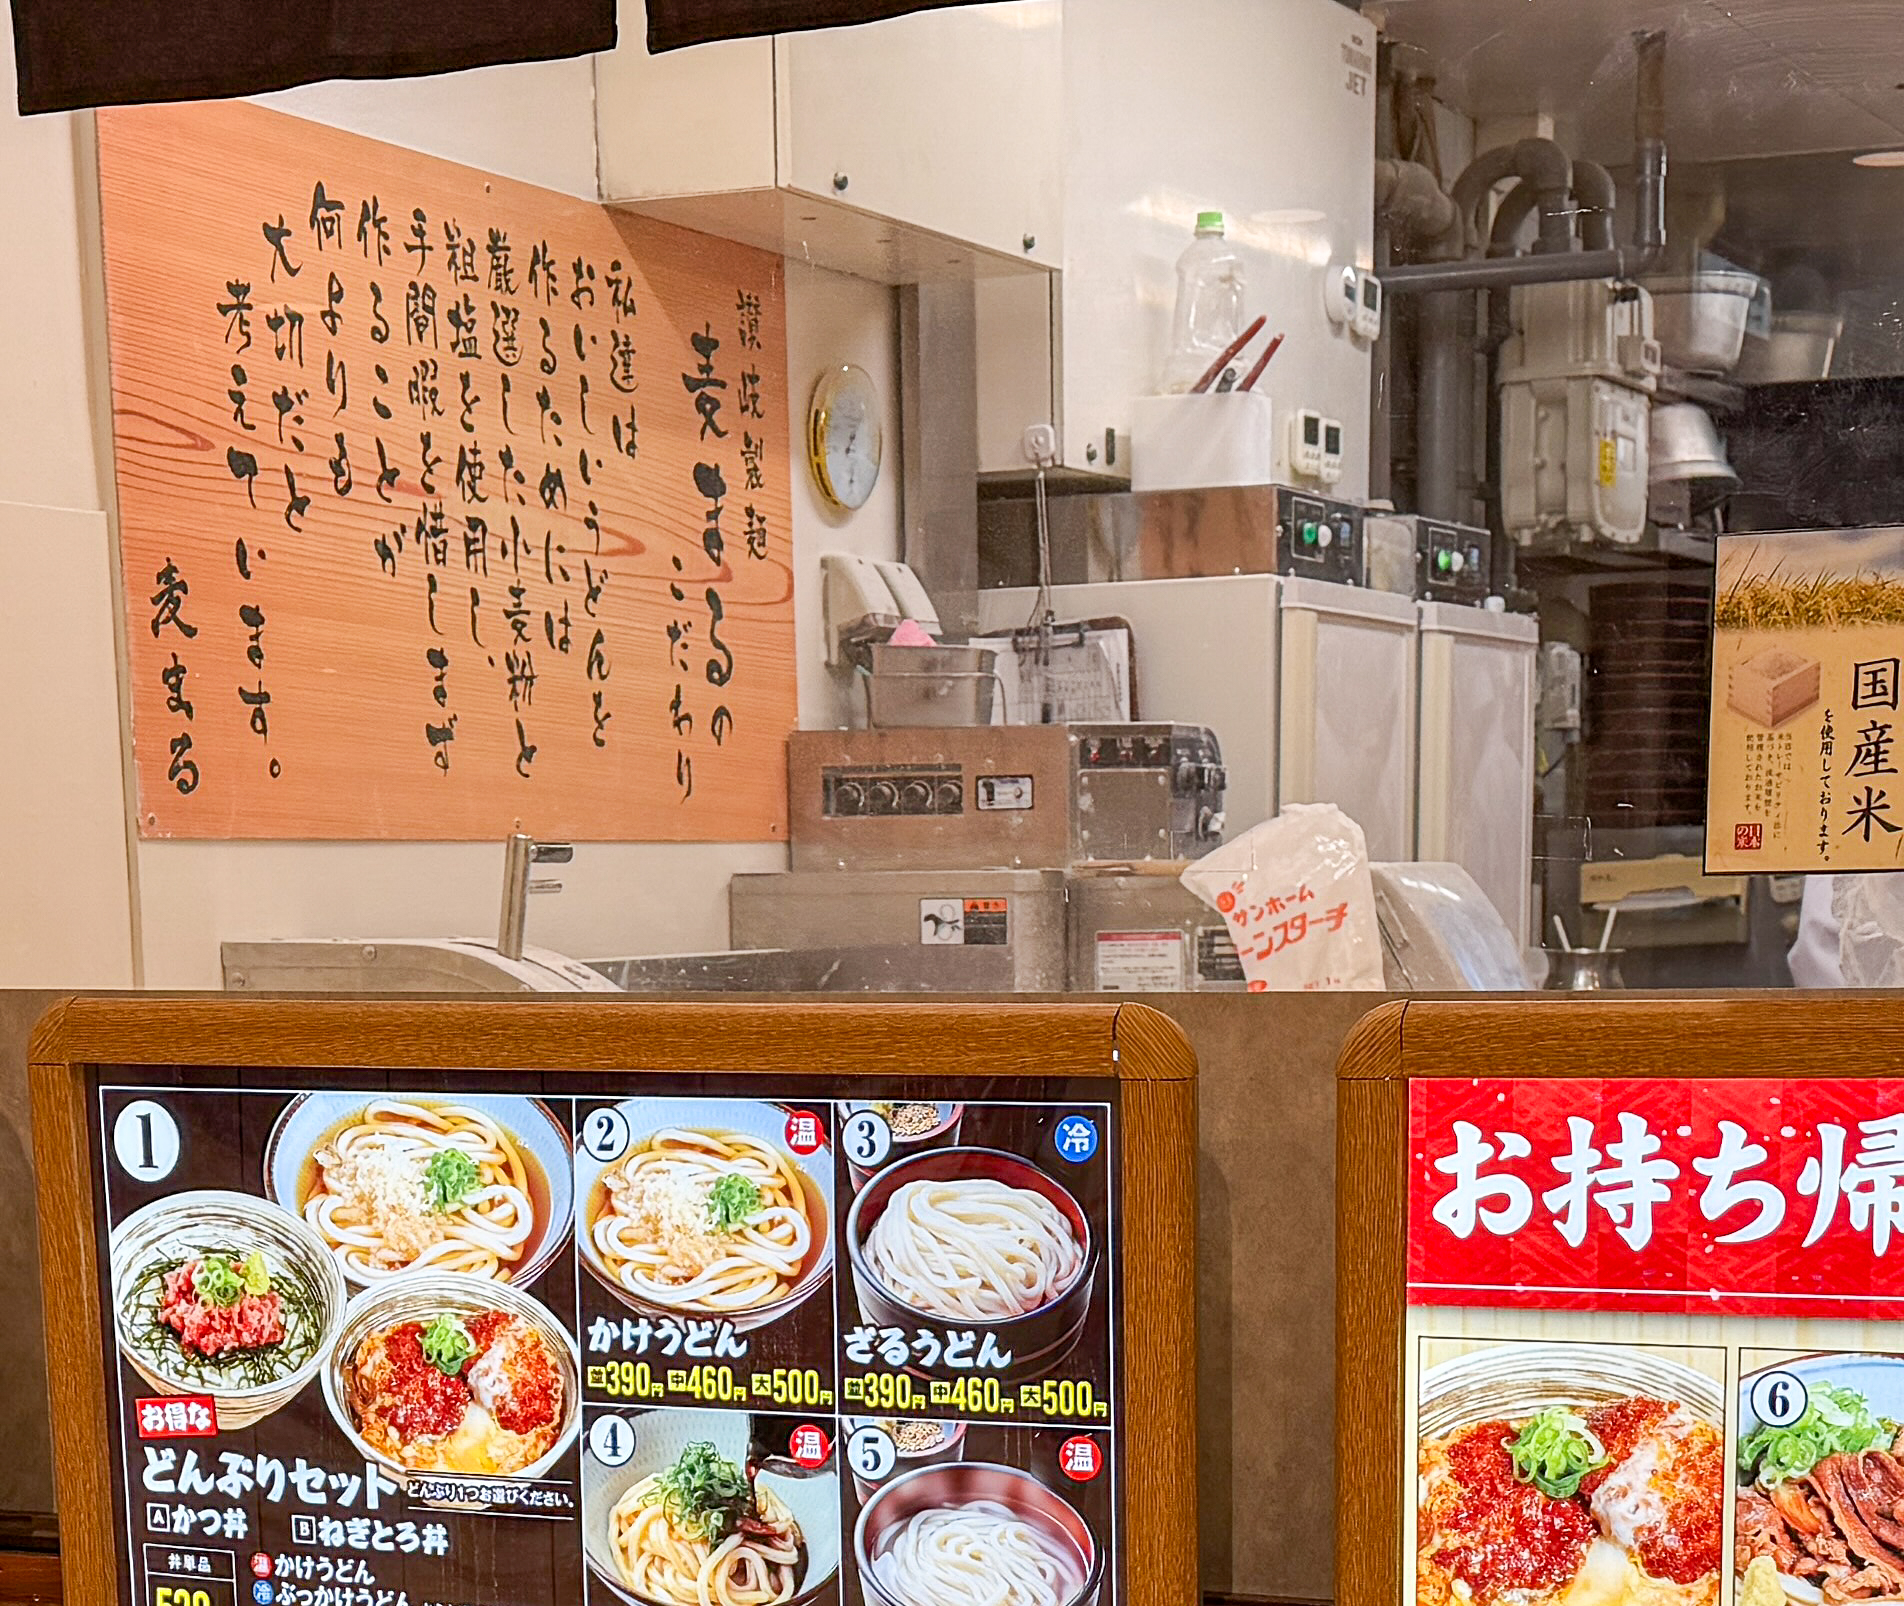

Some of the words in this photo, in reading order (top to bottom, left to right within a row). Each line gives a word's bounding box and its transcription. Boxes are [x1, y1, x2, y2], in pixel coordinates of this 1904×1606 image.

[263, 215, 310, 532] 大切だと
[308, 181, 352, 496] 何よりも
[357, 196, 408, 578] 作ることが
[217, 279, 282, 779] 考えています。
[528, 241, 573, 653] 作るためには
[571, 260, 612, 748] おいしいうどんを
[149, 557, 200, 795] 麦まる
[1842, 657, 1903, 842] 国産米
[1816, 709, 1836, 862] を使用しております。
[1233, 884, 1315, 927] サンホーム
[1237, 902, 1349, 961] ーンスターチ
[140, 1401, 213, 1434] お得な
[587, 1317, 748, 1360] かけうどん
[844, 1325, 1013, 1369] ざるうどん
[141, 1448, 399, 1511] どんぶりセット
[275, 1552, 375, 1585] かけうどん
